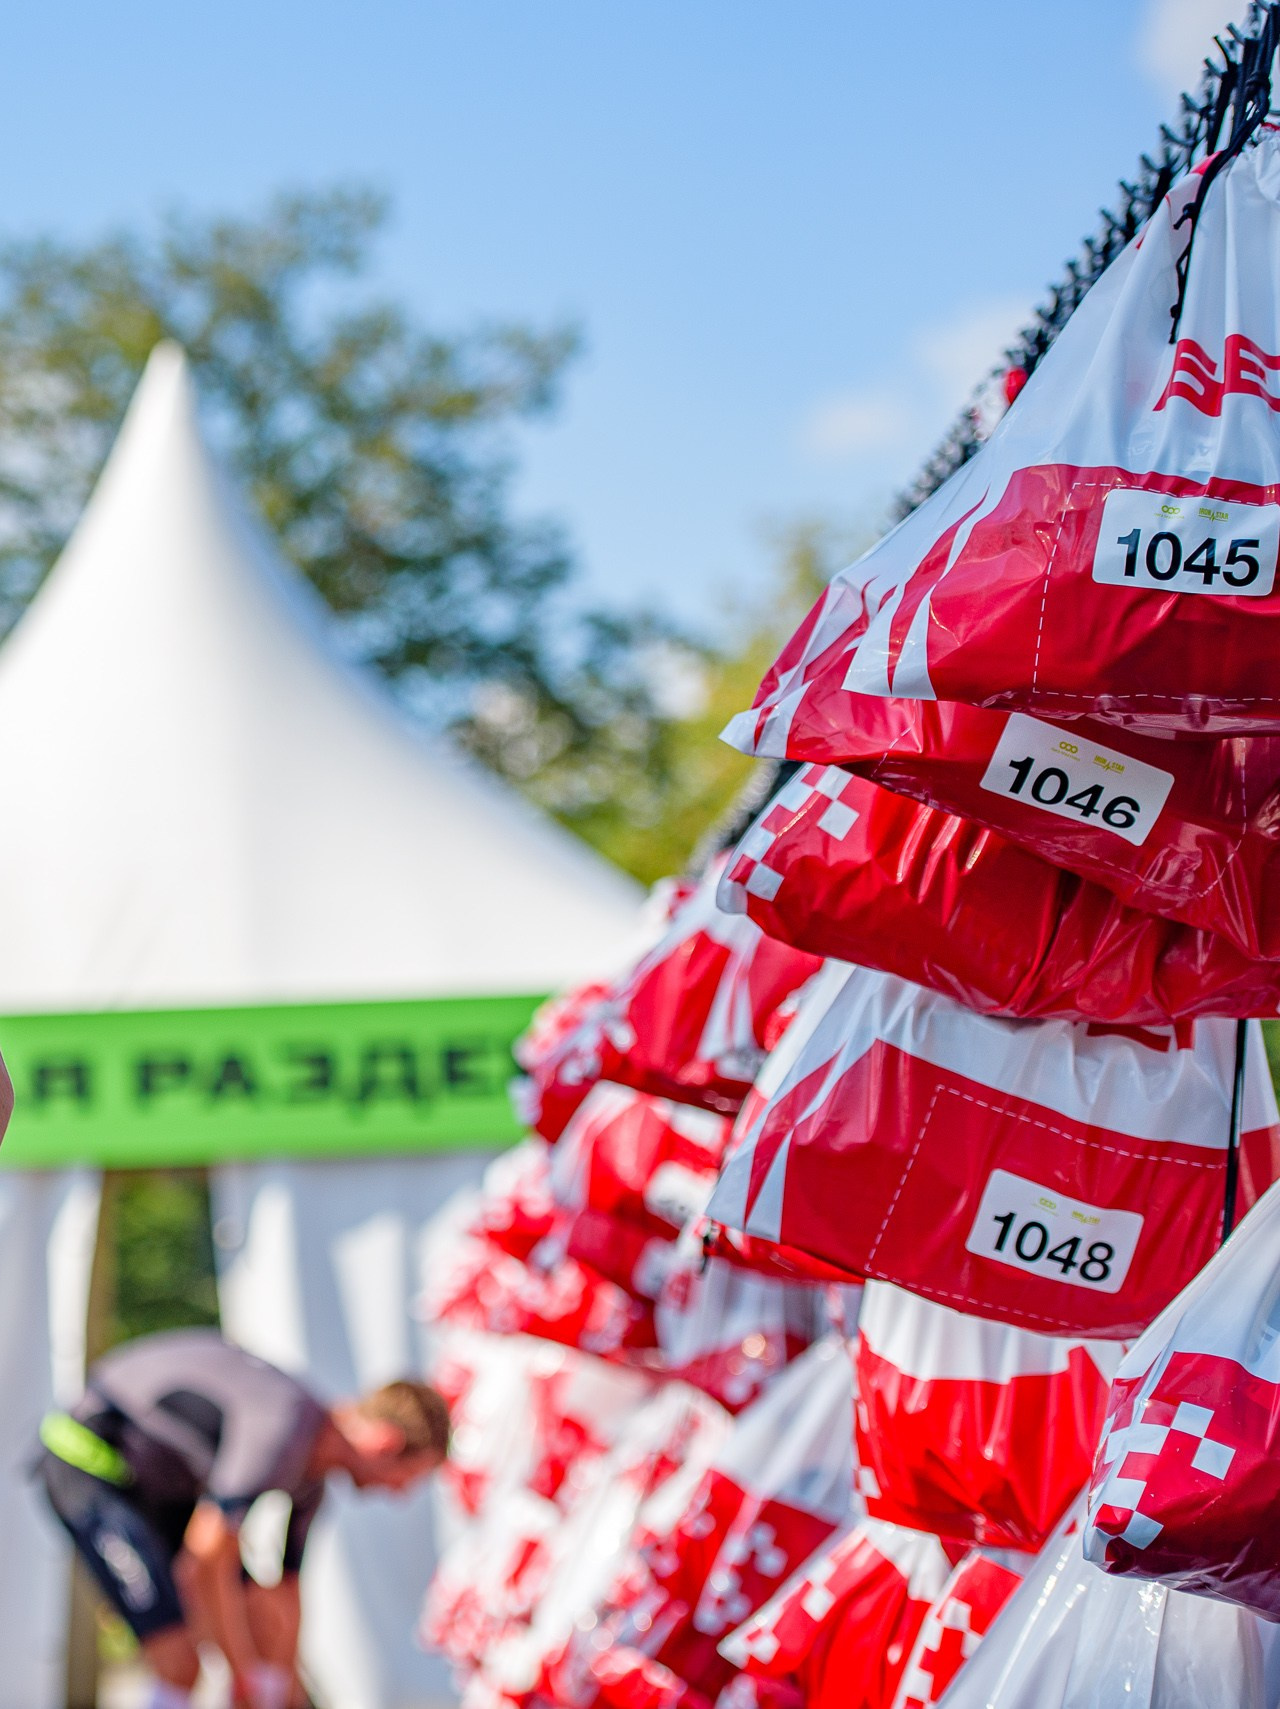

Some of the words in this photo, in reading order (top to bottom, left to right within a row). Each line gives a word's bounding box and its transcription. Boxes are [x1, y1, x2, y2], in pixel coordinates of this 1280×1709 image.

[1117, 528, 1260, 587] 1045
[1009, 756, 1141, 828] 1046
[130, 1040, 520, 1122] РАЗДЕ
[993, 1212, 1116, 1283] 1048
